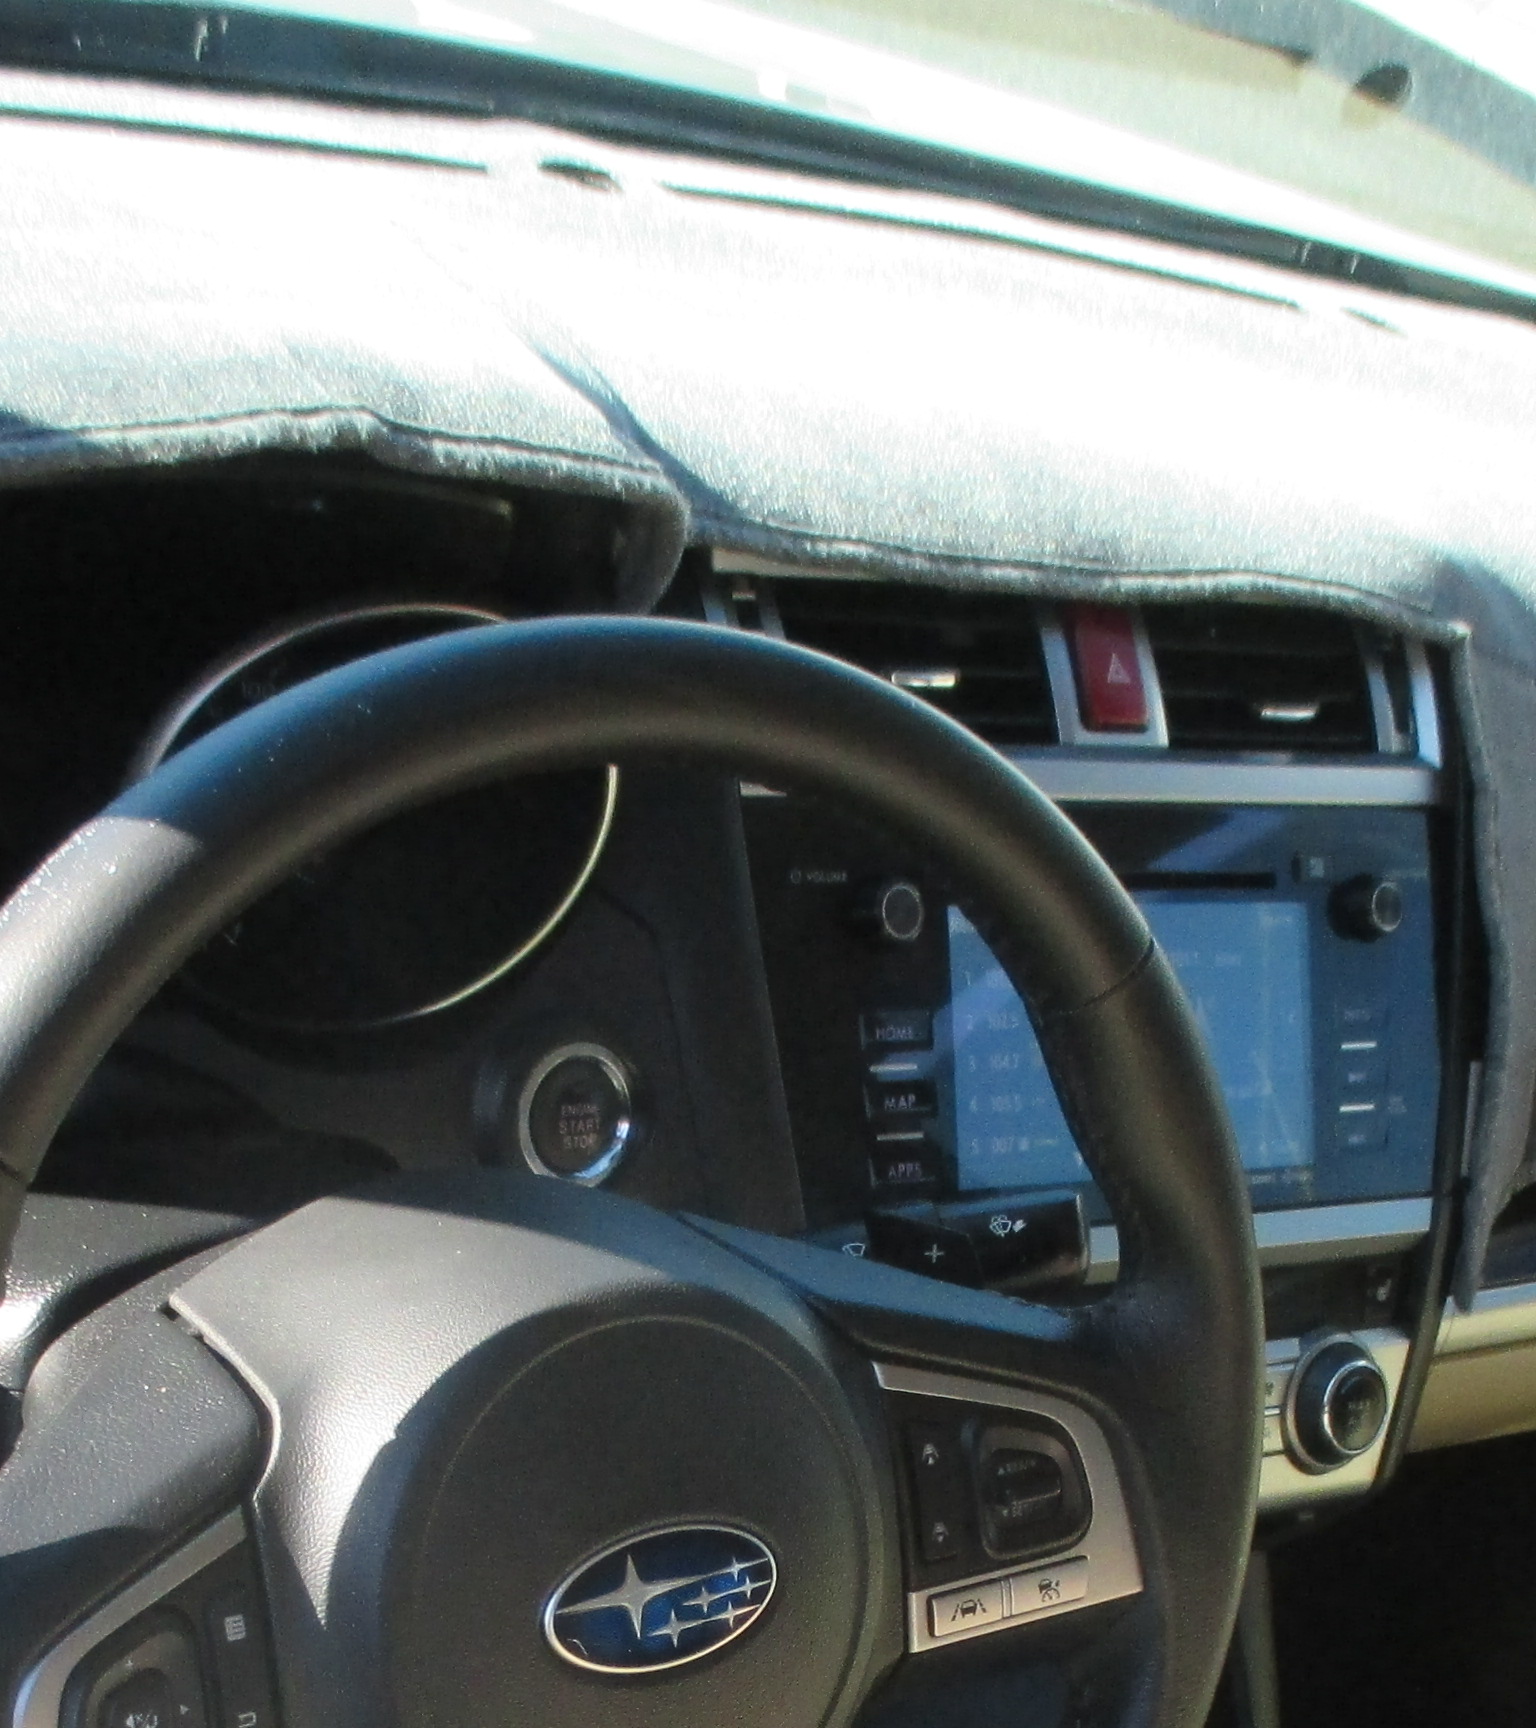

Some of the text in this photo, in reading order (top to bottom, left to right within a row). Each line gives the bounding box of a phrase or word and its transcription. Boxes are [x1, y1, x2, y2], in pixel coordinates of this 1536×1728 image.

[874, 1025, 915, 1041] HOME
[883, 1093, 917, 1111] MAP
[558, 1119, 600, 1135] START
[563, 1133, 598, 1150] STOP
[887, 1162, 924, 1181] APPS
